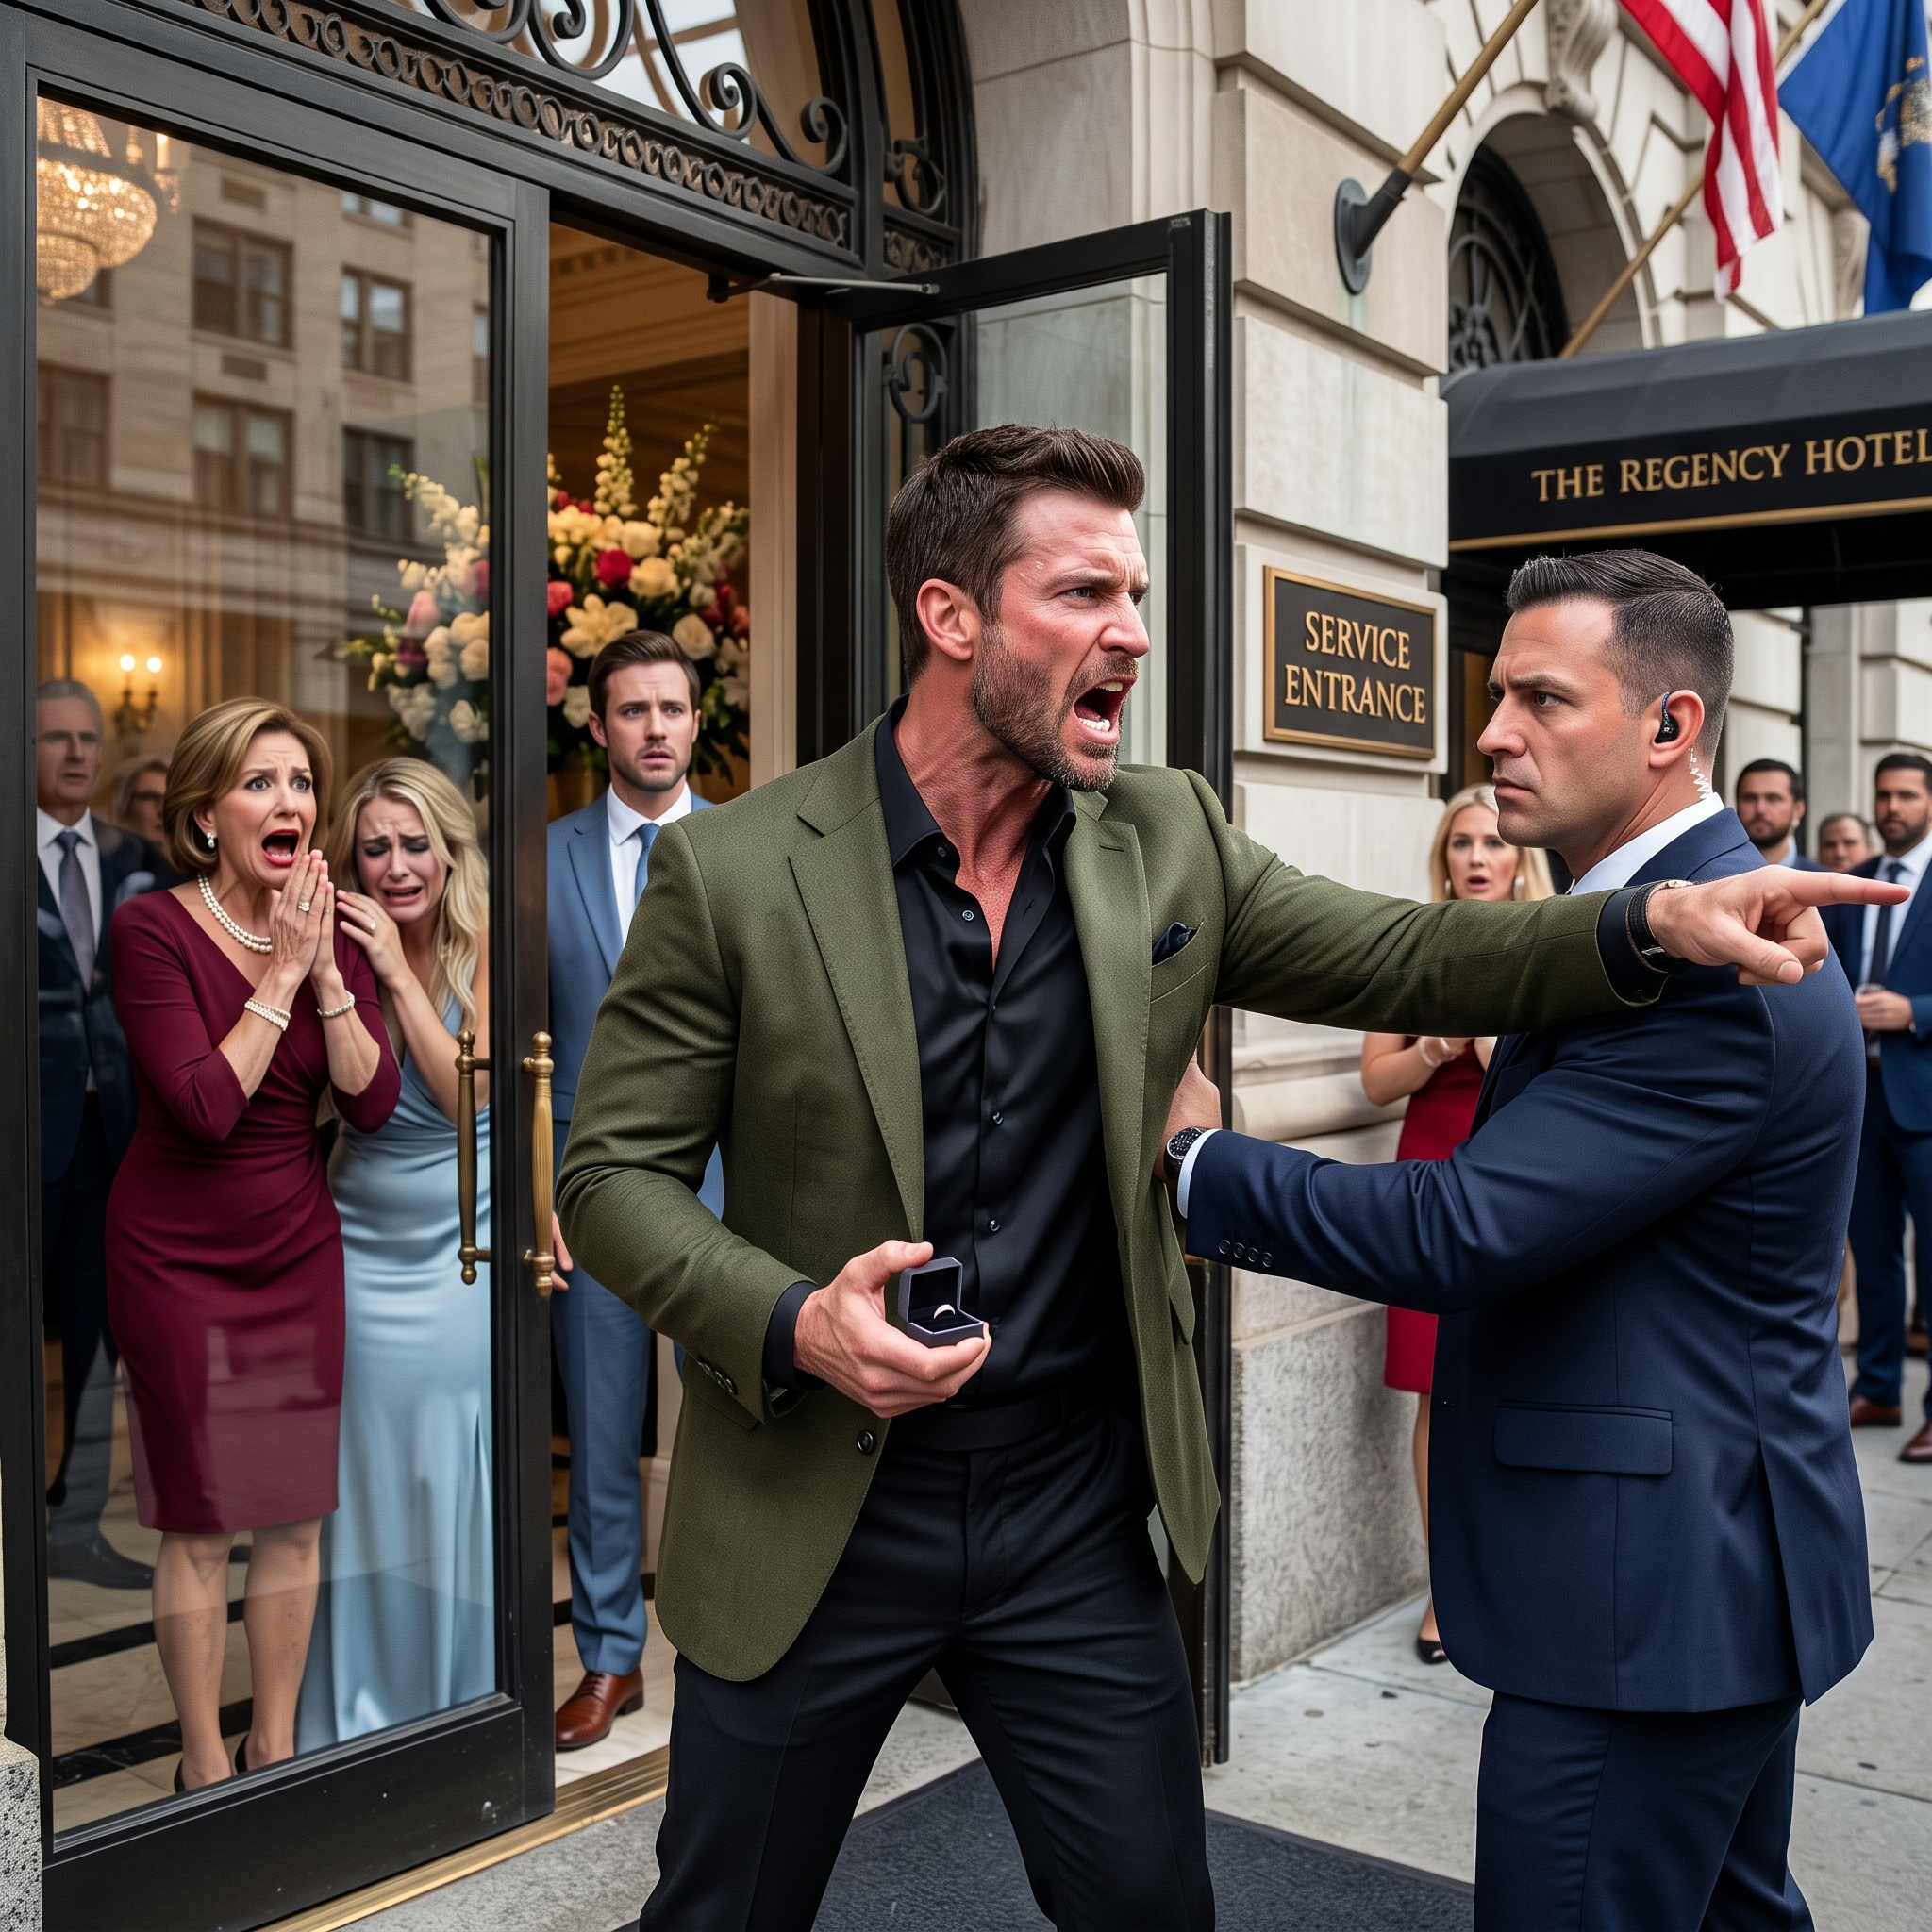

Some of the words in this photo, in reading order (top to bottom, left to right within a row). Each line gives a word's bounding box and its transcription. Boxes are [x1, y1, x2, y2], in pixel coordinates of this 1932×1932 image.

[1531, 463, 1605, 502] THE
[1619, 443, 1790, 493] REGENCY
[1805, 428, 1932, 475] HOTEL
[1305, 610, 1411, 670] SERVICE
[1284, 663, 1426, 724] ENTRANCE
